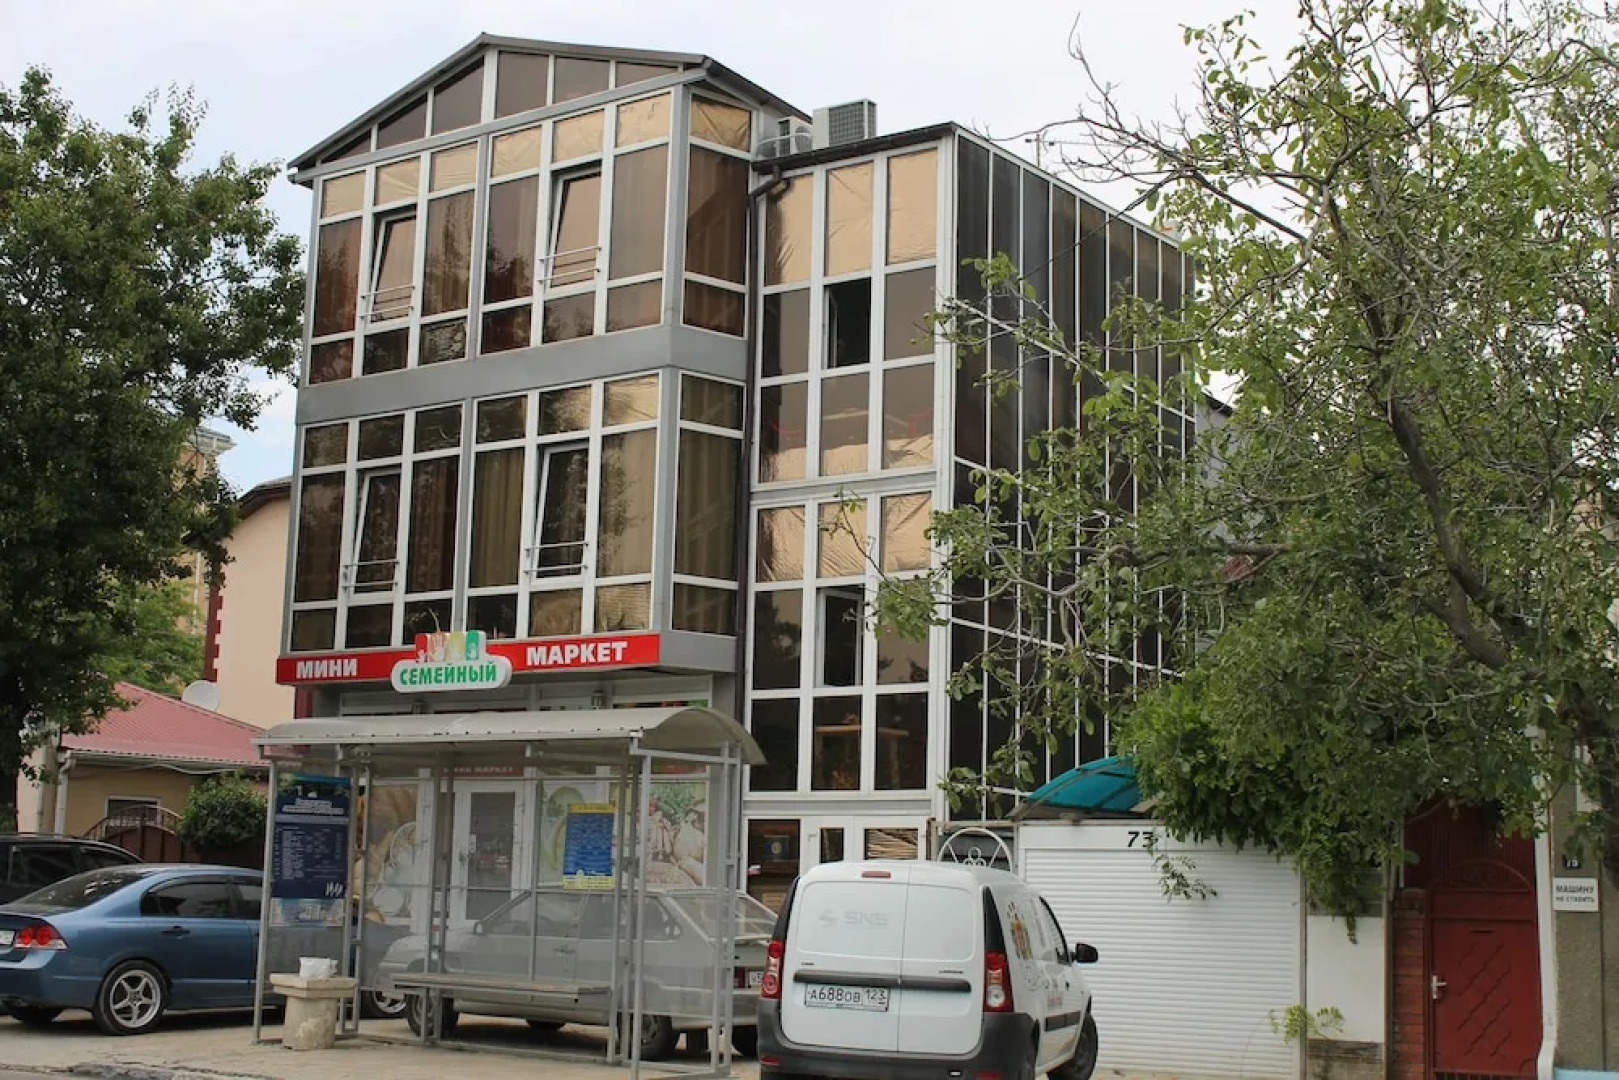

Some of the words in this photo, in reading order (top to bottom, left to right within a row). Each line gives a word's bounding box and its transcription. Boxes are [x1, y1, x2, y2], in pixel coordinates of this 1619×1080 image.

[296, 658, 357, 680] МИНИ
[526, 640, 628, 666] МАРКЕТ
[400, 660, 497, 686] СЕМЕЙНЫЙ
[844, 911, 888, 927] SNS
